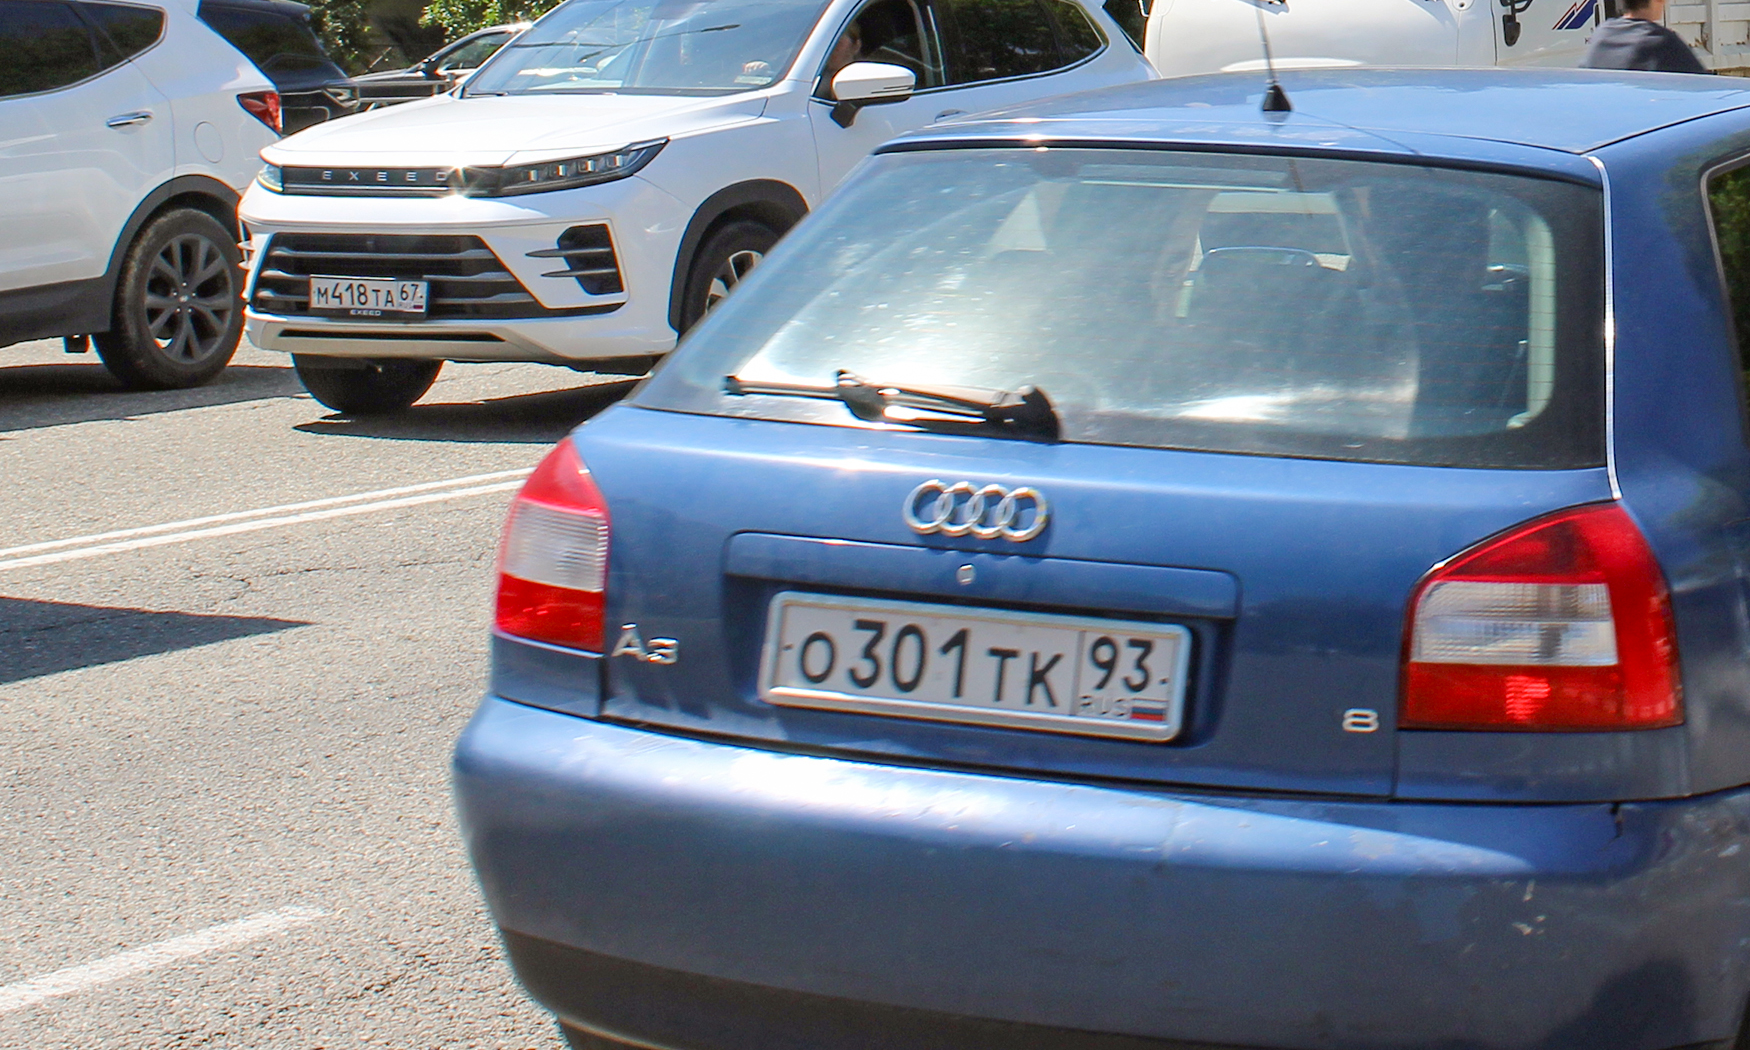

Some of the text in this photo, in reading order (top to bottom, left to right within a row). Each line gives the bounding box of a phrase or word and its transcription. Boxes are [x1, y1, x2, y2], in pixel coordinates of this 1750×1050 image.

[322, 170, 447, 182] EXEED
[400, 283, 419, 301] 67
[611, 622, 679, 665] A3
[1090, 636, 1153, 692] 93
[1342, 707, 1379, 733] 8
